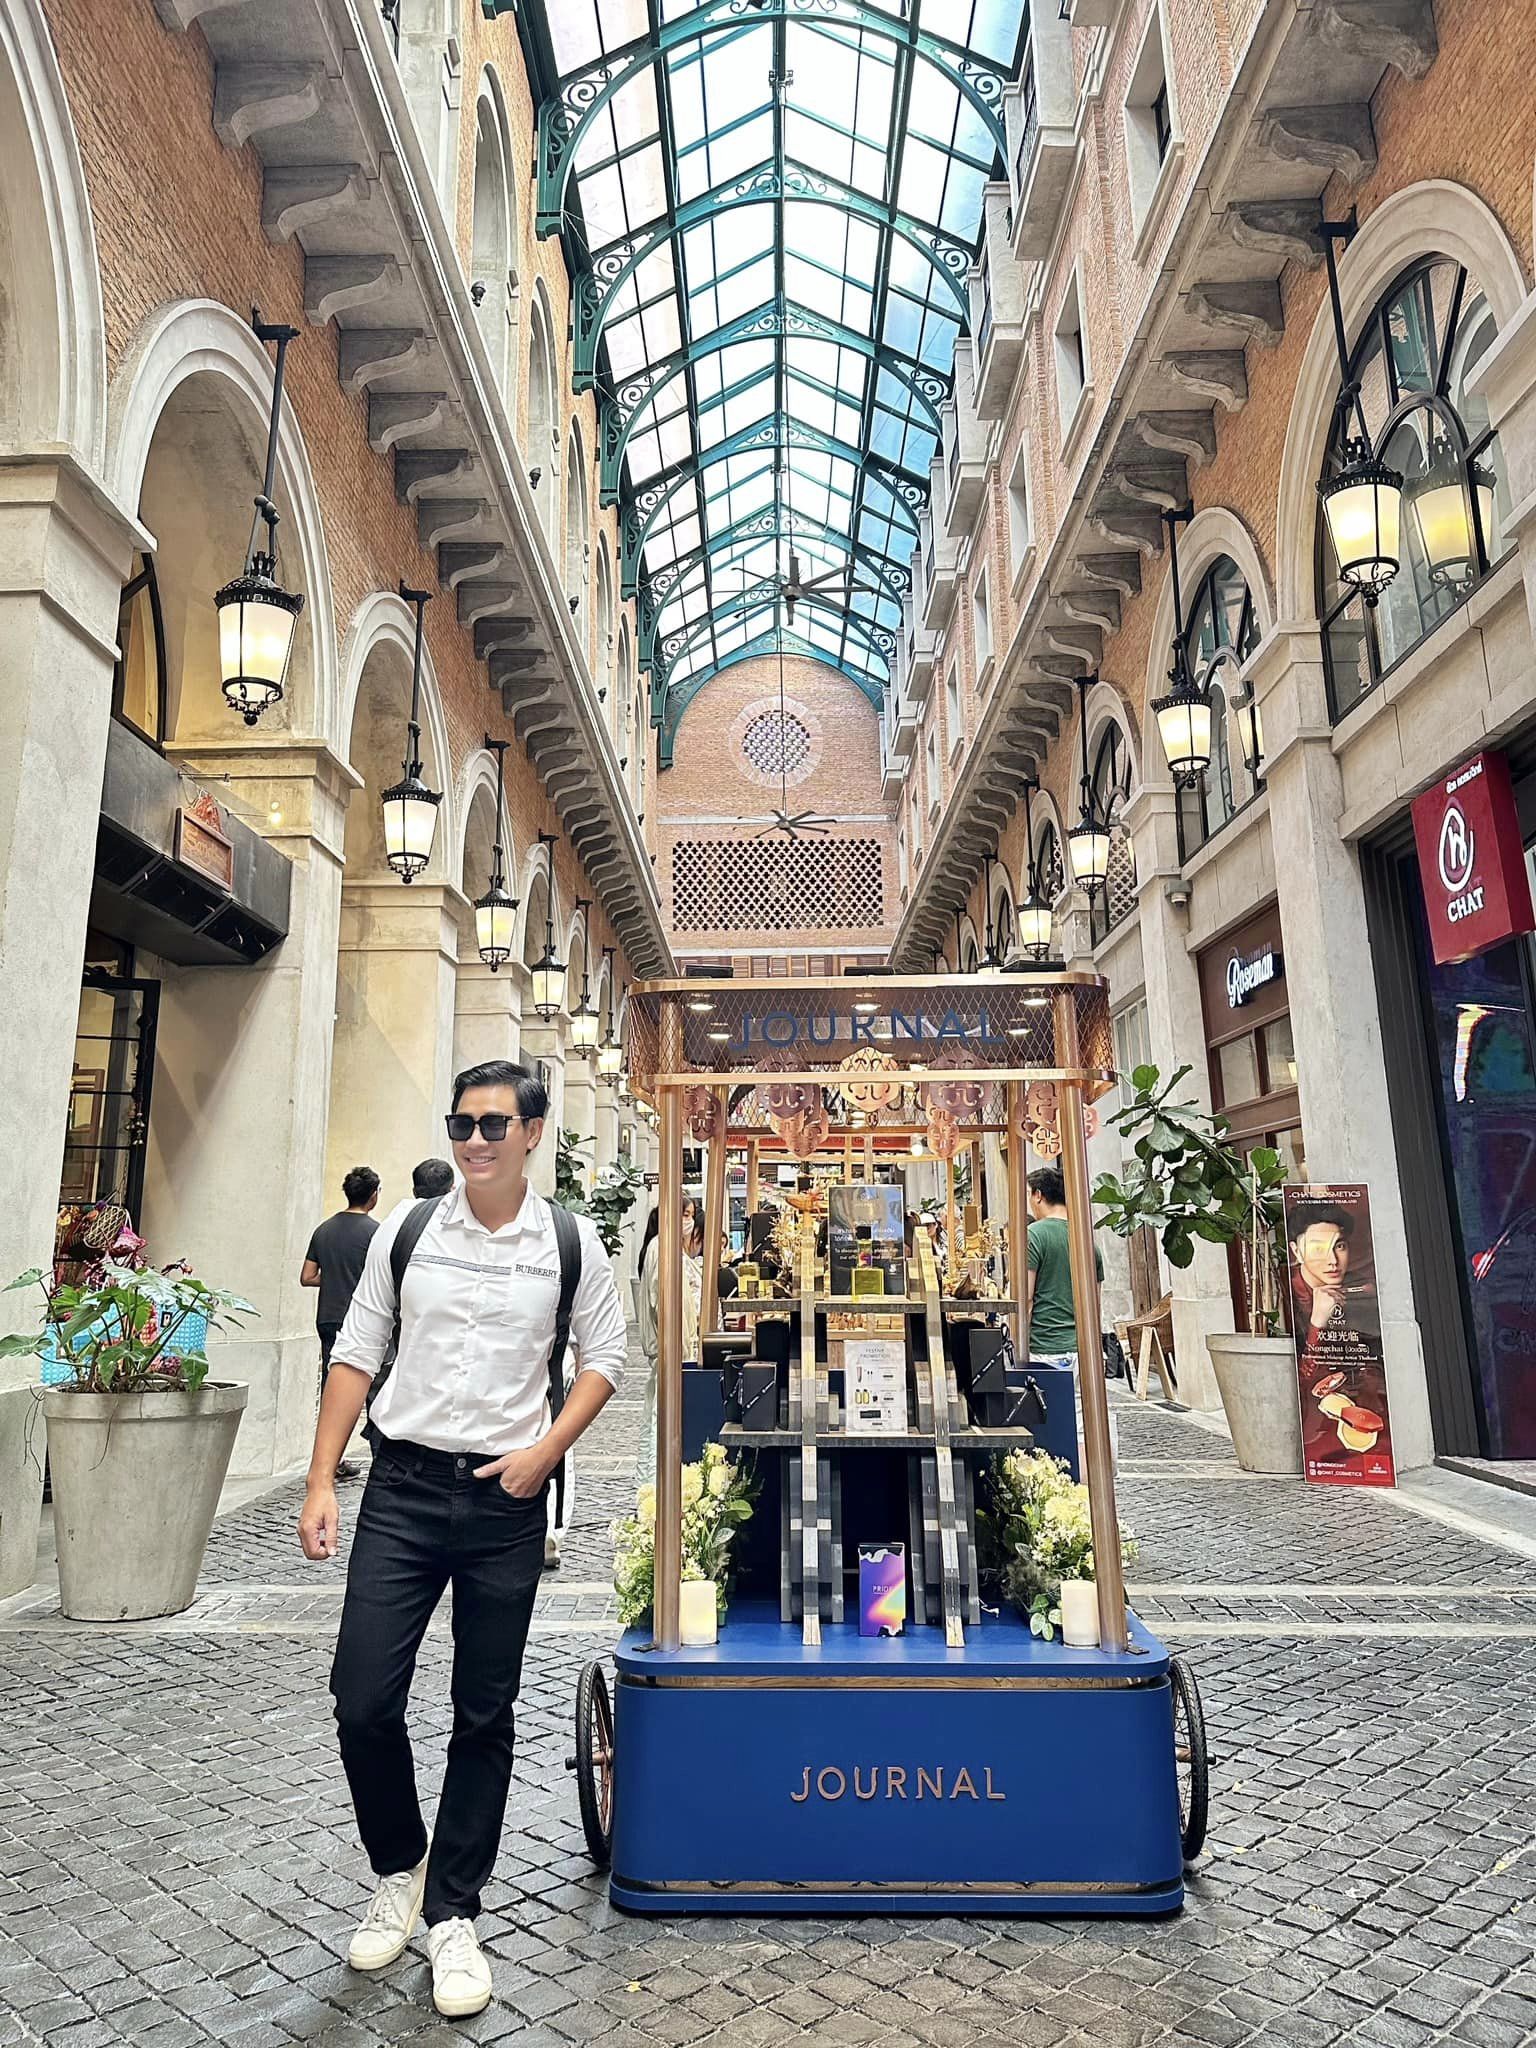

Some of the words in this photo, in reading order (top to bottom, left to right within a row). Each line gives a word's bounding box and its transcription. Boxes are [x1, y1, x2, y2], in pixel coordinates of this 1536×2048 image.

[1447, 886, 1484, 923] CHAT
[1227, 952, 1274, 1008] Roseman
[728, 1007, 1006, 1051] JOURNAL
[1316, 1190, 1361, 1198] COSMETICS
[515, 1263, 559, 1279] BURBERRY
[1315, 1329, 1359, 1342] 欢迎光临
[1307, 1343, 1344, 1354] Nongchat
[790, 1766, 1006, 1801] JOURNAL
